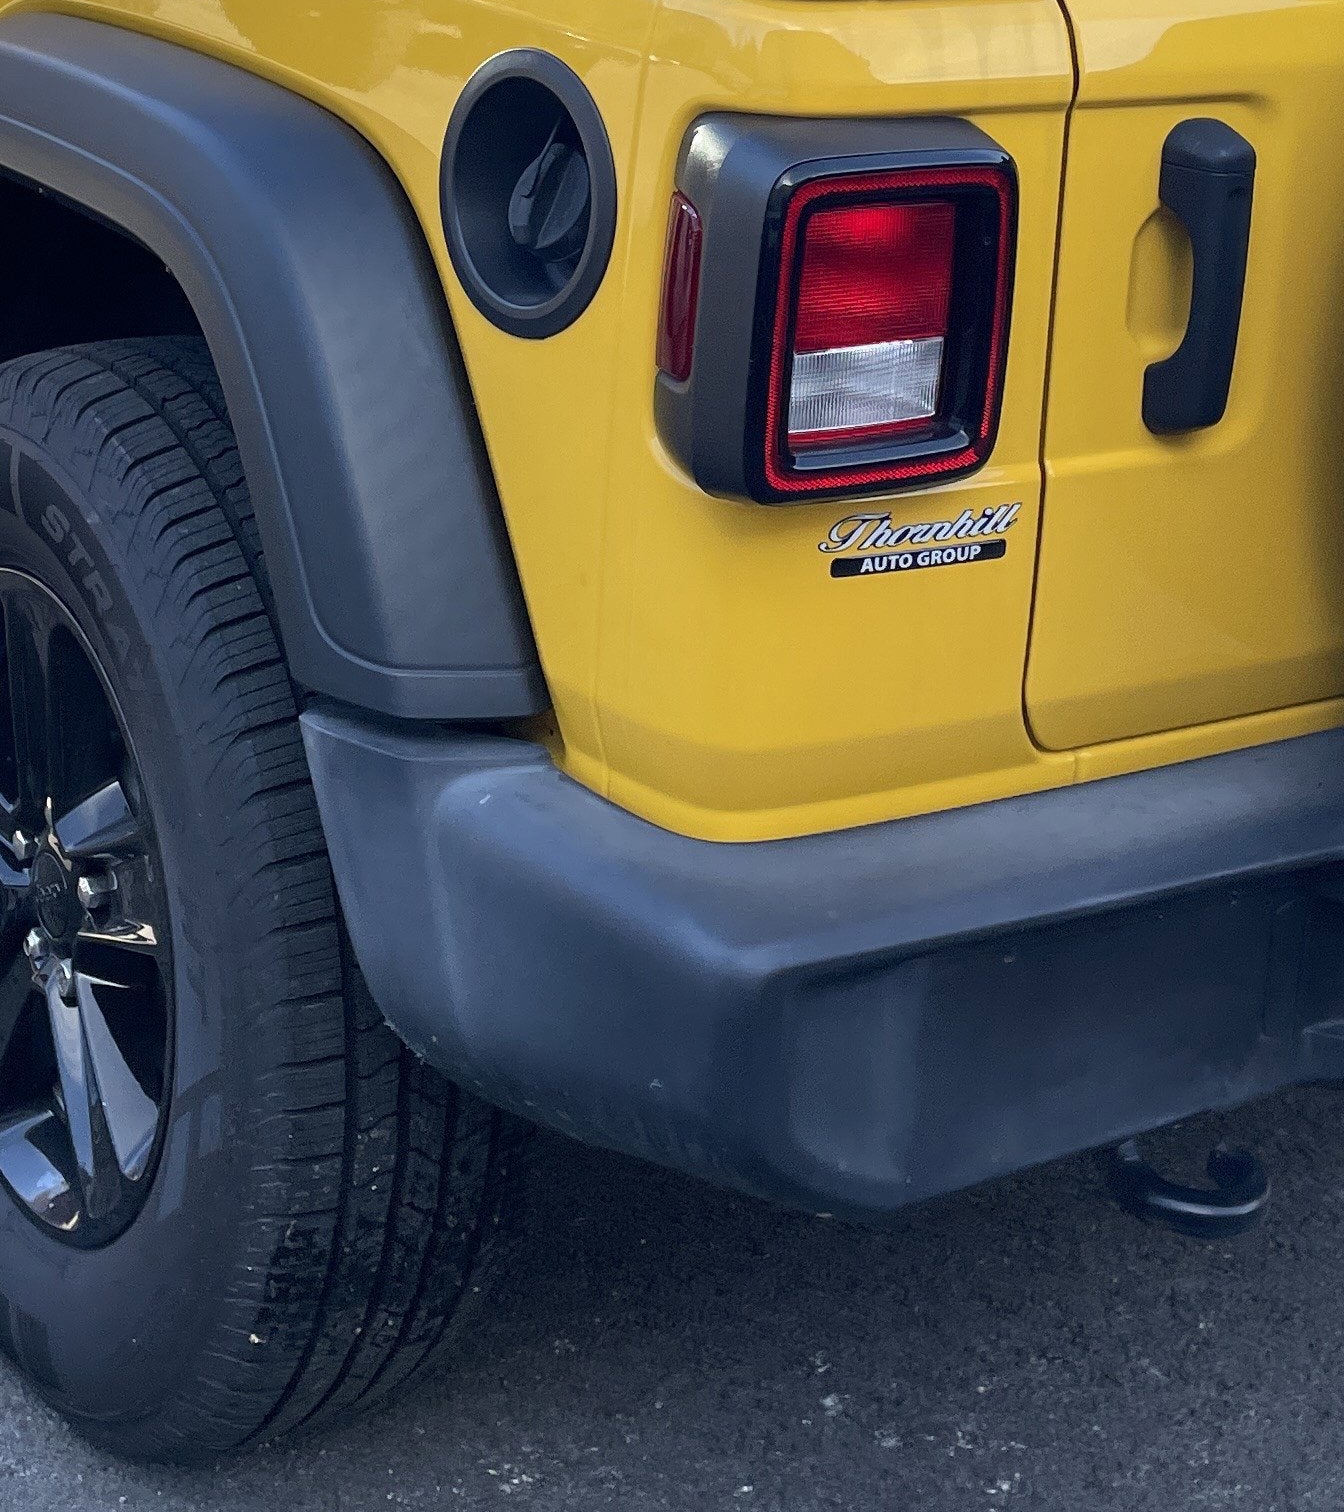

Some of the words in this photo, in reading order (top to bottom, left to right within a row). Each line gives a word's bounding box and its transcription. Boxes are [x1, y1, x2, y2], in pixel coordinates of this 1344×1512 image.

[818, 501, 1023, 553] Thornhill
[859, 554, 913, 574] AUTO
[916, 545, 982, 566] GROUP
